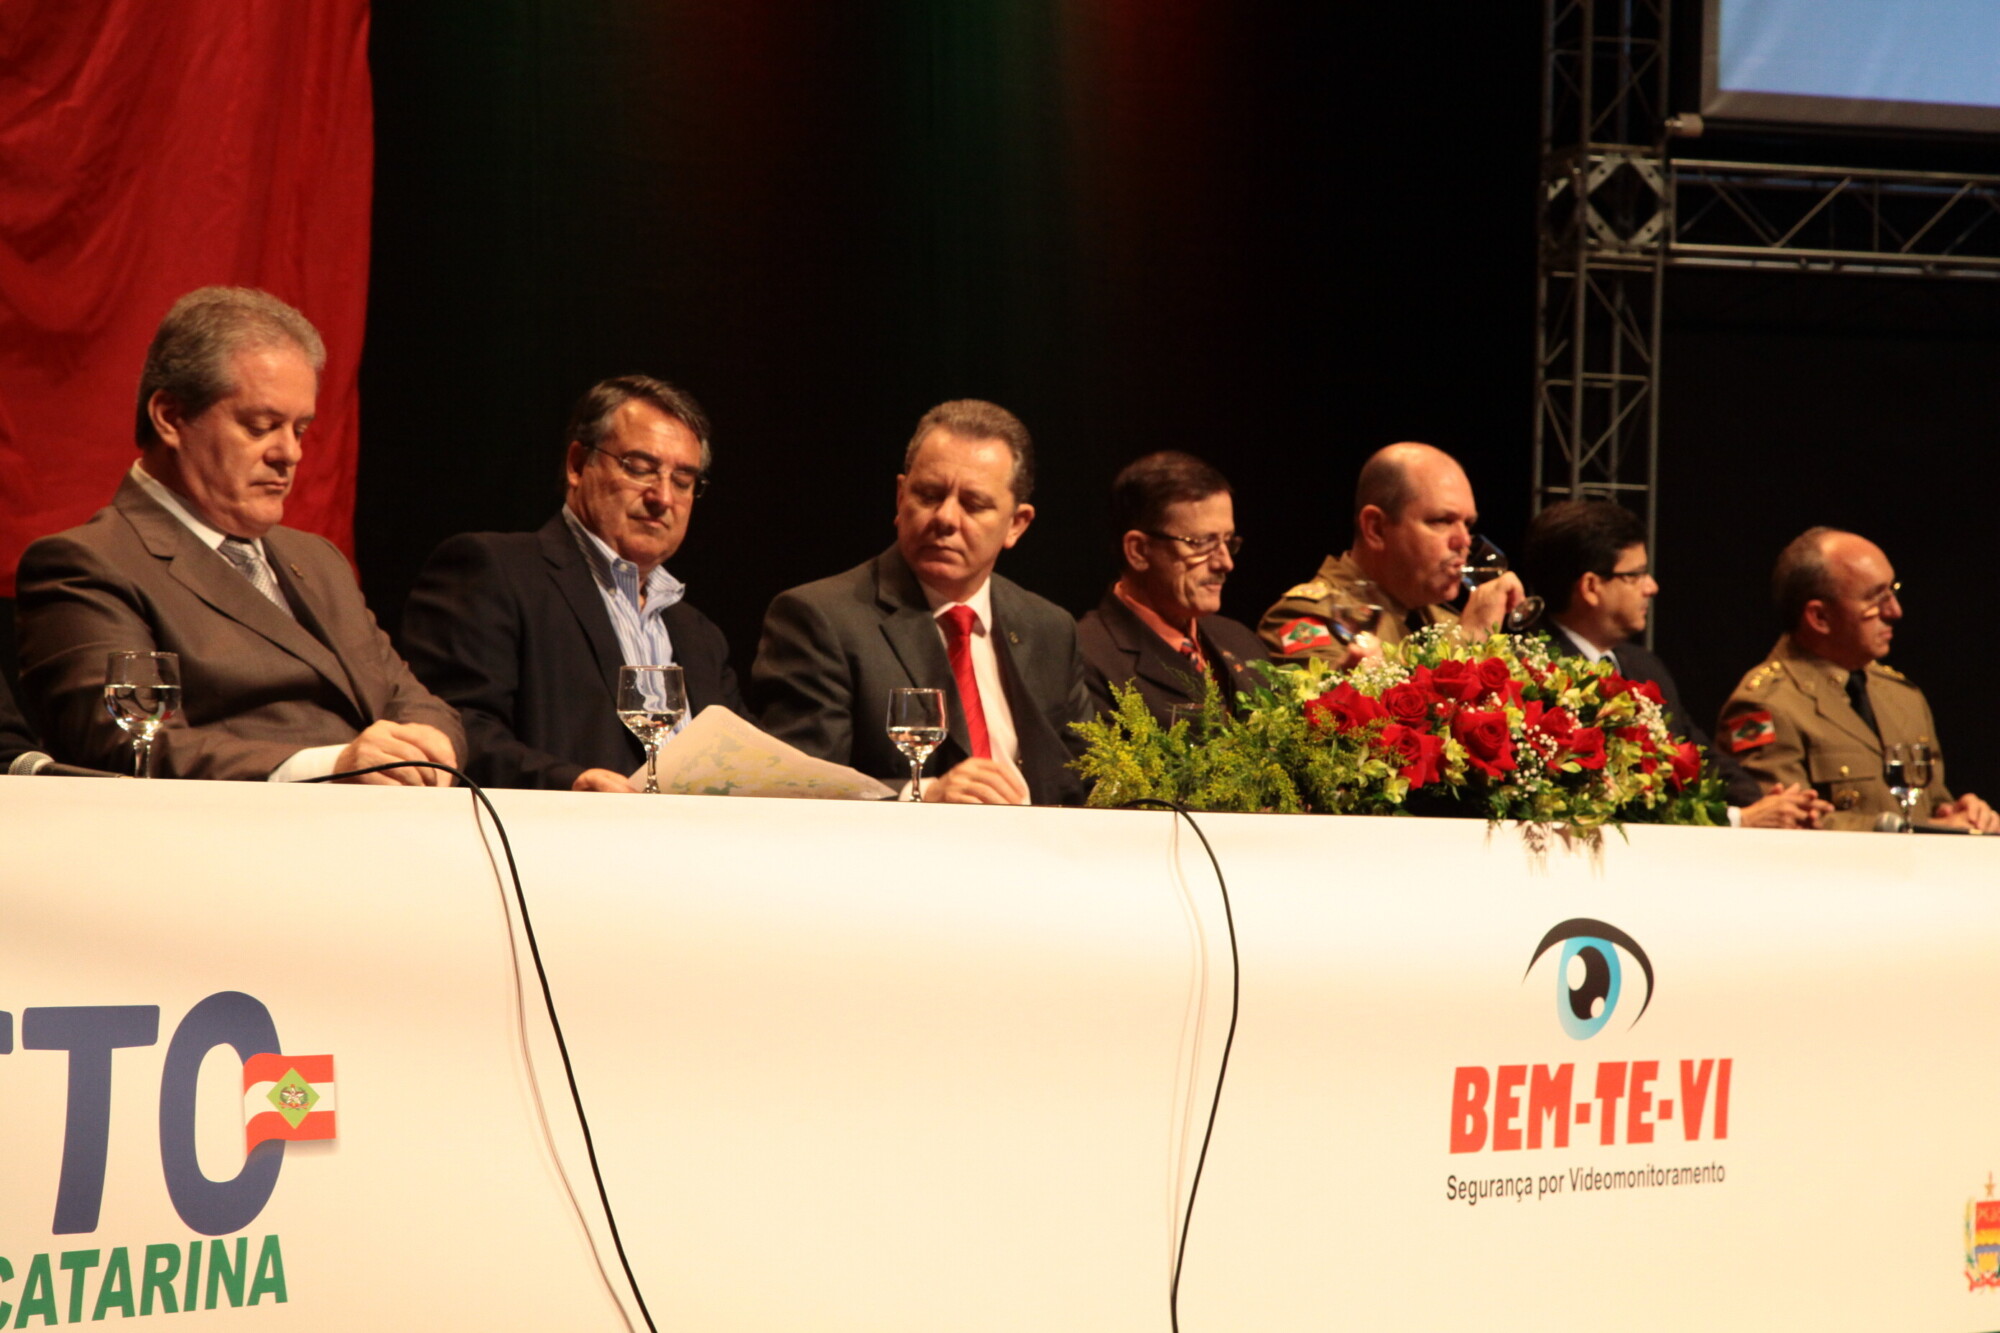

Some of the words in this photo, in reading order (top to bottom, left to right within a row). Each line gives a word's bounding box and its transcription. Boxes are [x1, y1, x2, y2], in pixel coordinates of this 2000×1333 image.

[0, 990, 286, 1237] TO
[1449, 1058, 1733, 1154] BEM-TE-VI
[1446, 1174, 1532, 1206] Segurança
[1538, 1173, 1565, 1200] por
[1569, 1161, 1725, 1192] Videomonitoramento
